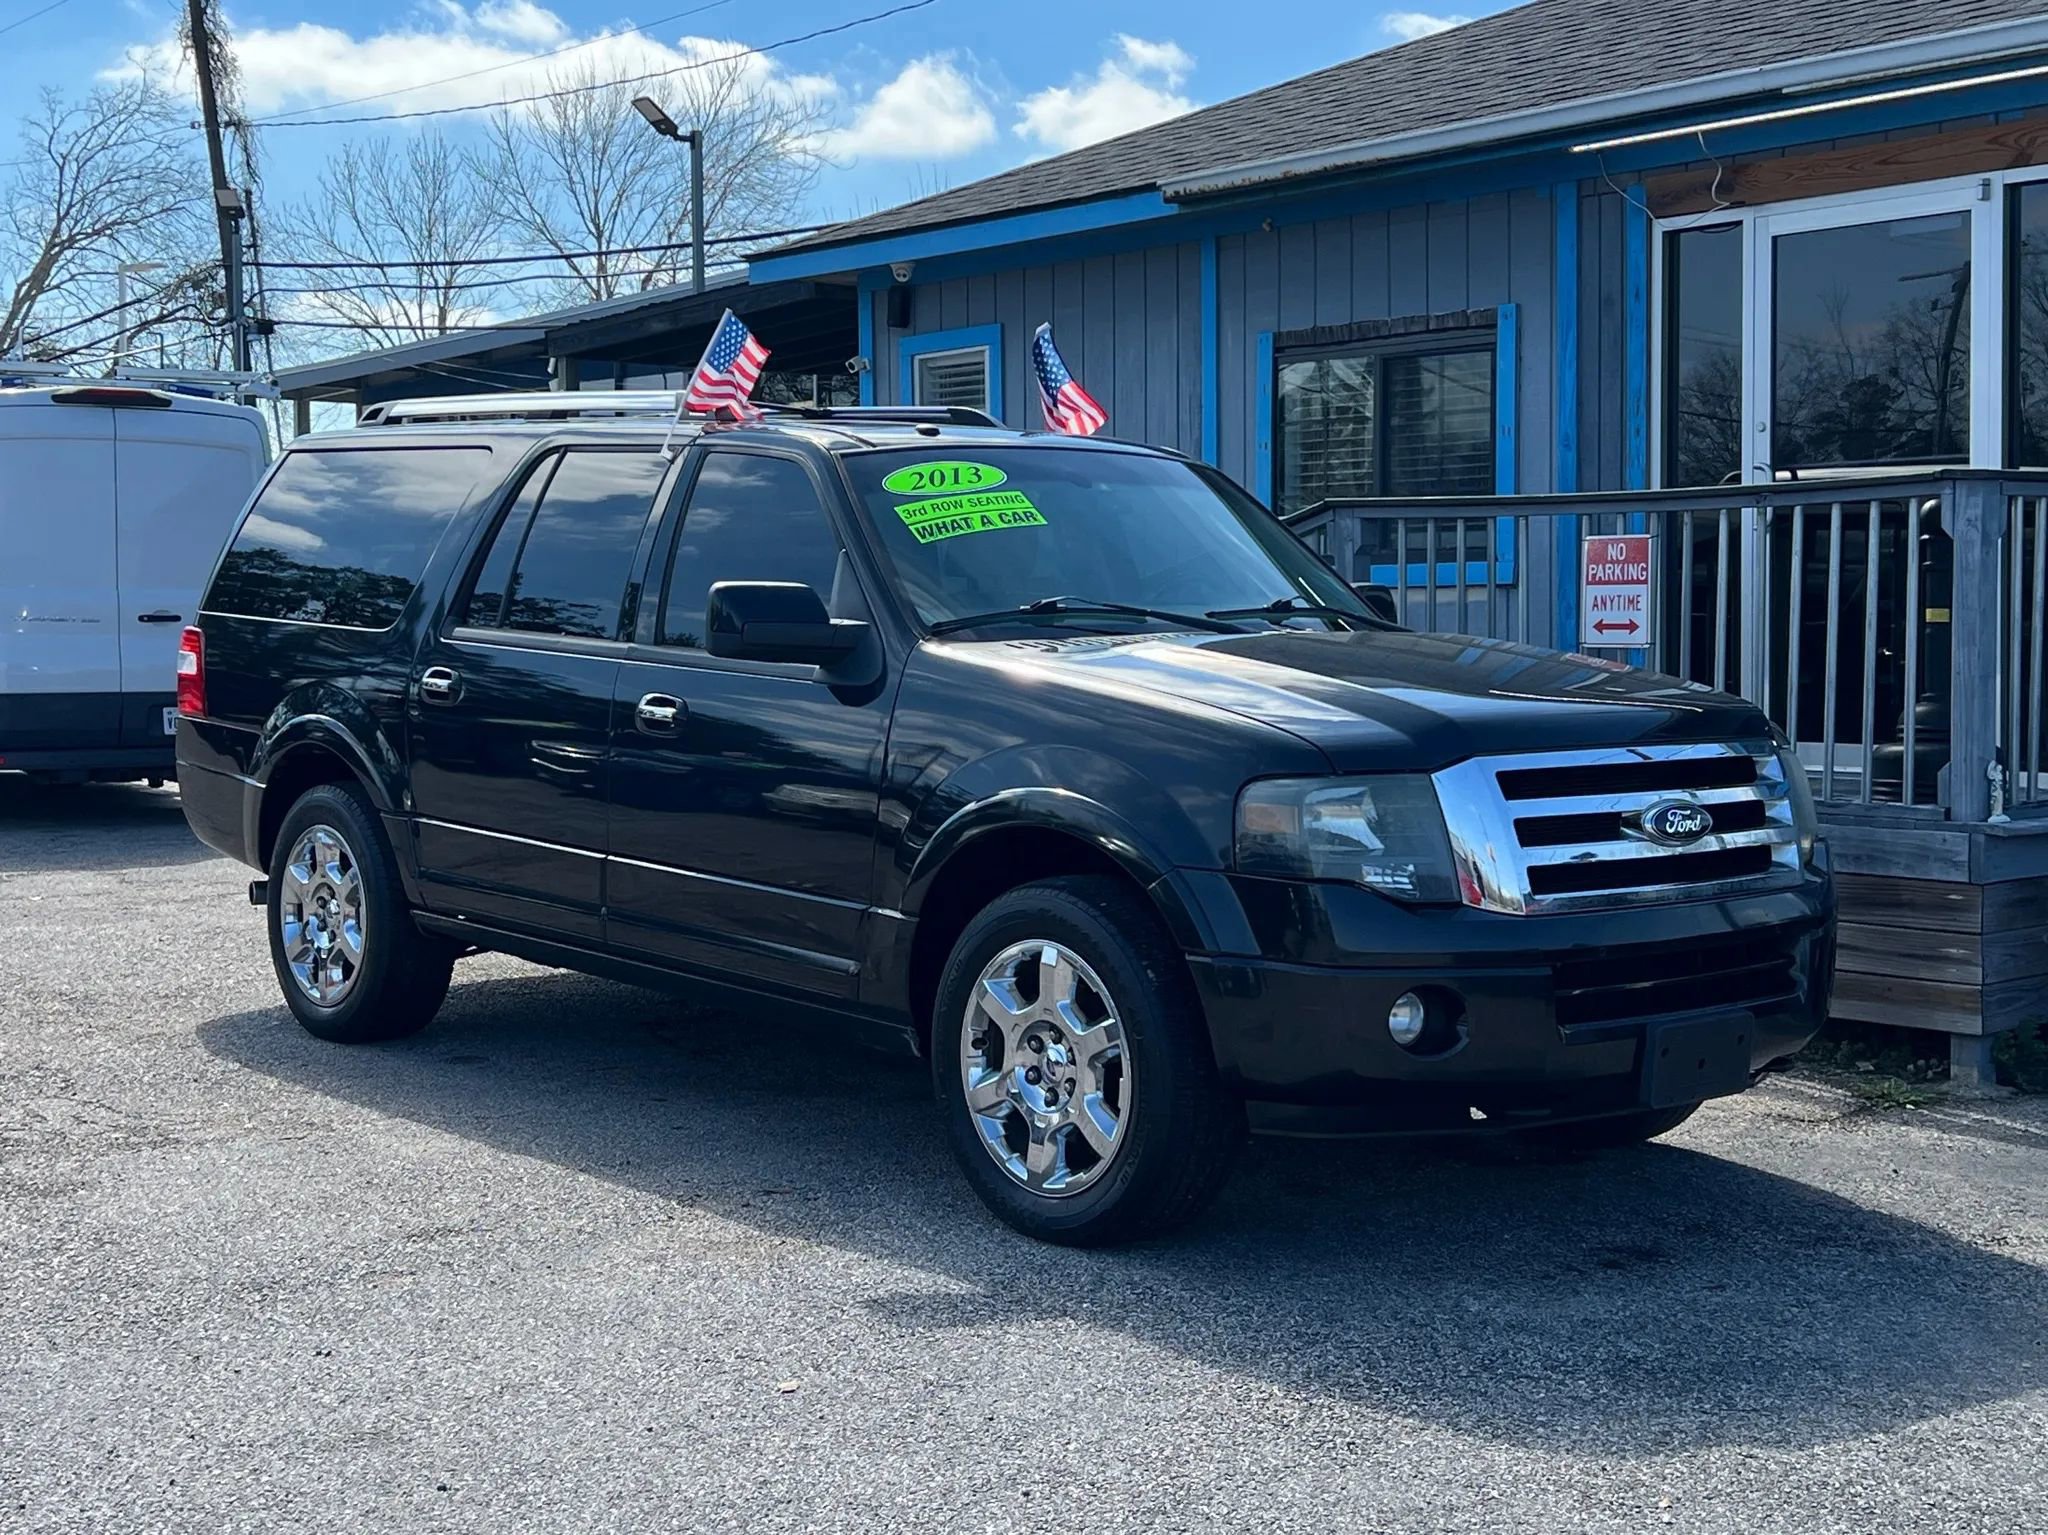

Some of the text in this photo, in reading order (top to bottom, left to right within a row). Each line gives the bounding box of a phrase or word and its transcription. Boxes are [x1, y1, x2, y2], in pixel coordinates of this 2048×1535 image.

[909, 466, 983, 492] 2013
[902, 494, 1026, 520] 3rd ROW SEATING
[914, 511, 1038, 540] WHAT A CAR
[1607, 542, 1627, 560] NO
[1588, 562, 1648, 581] PARKING
[1591, 594, 1642, 611] ANYTIME
[1665, 809, 1702, 833] Ford
